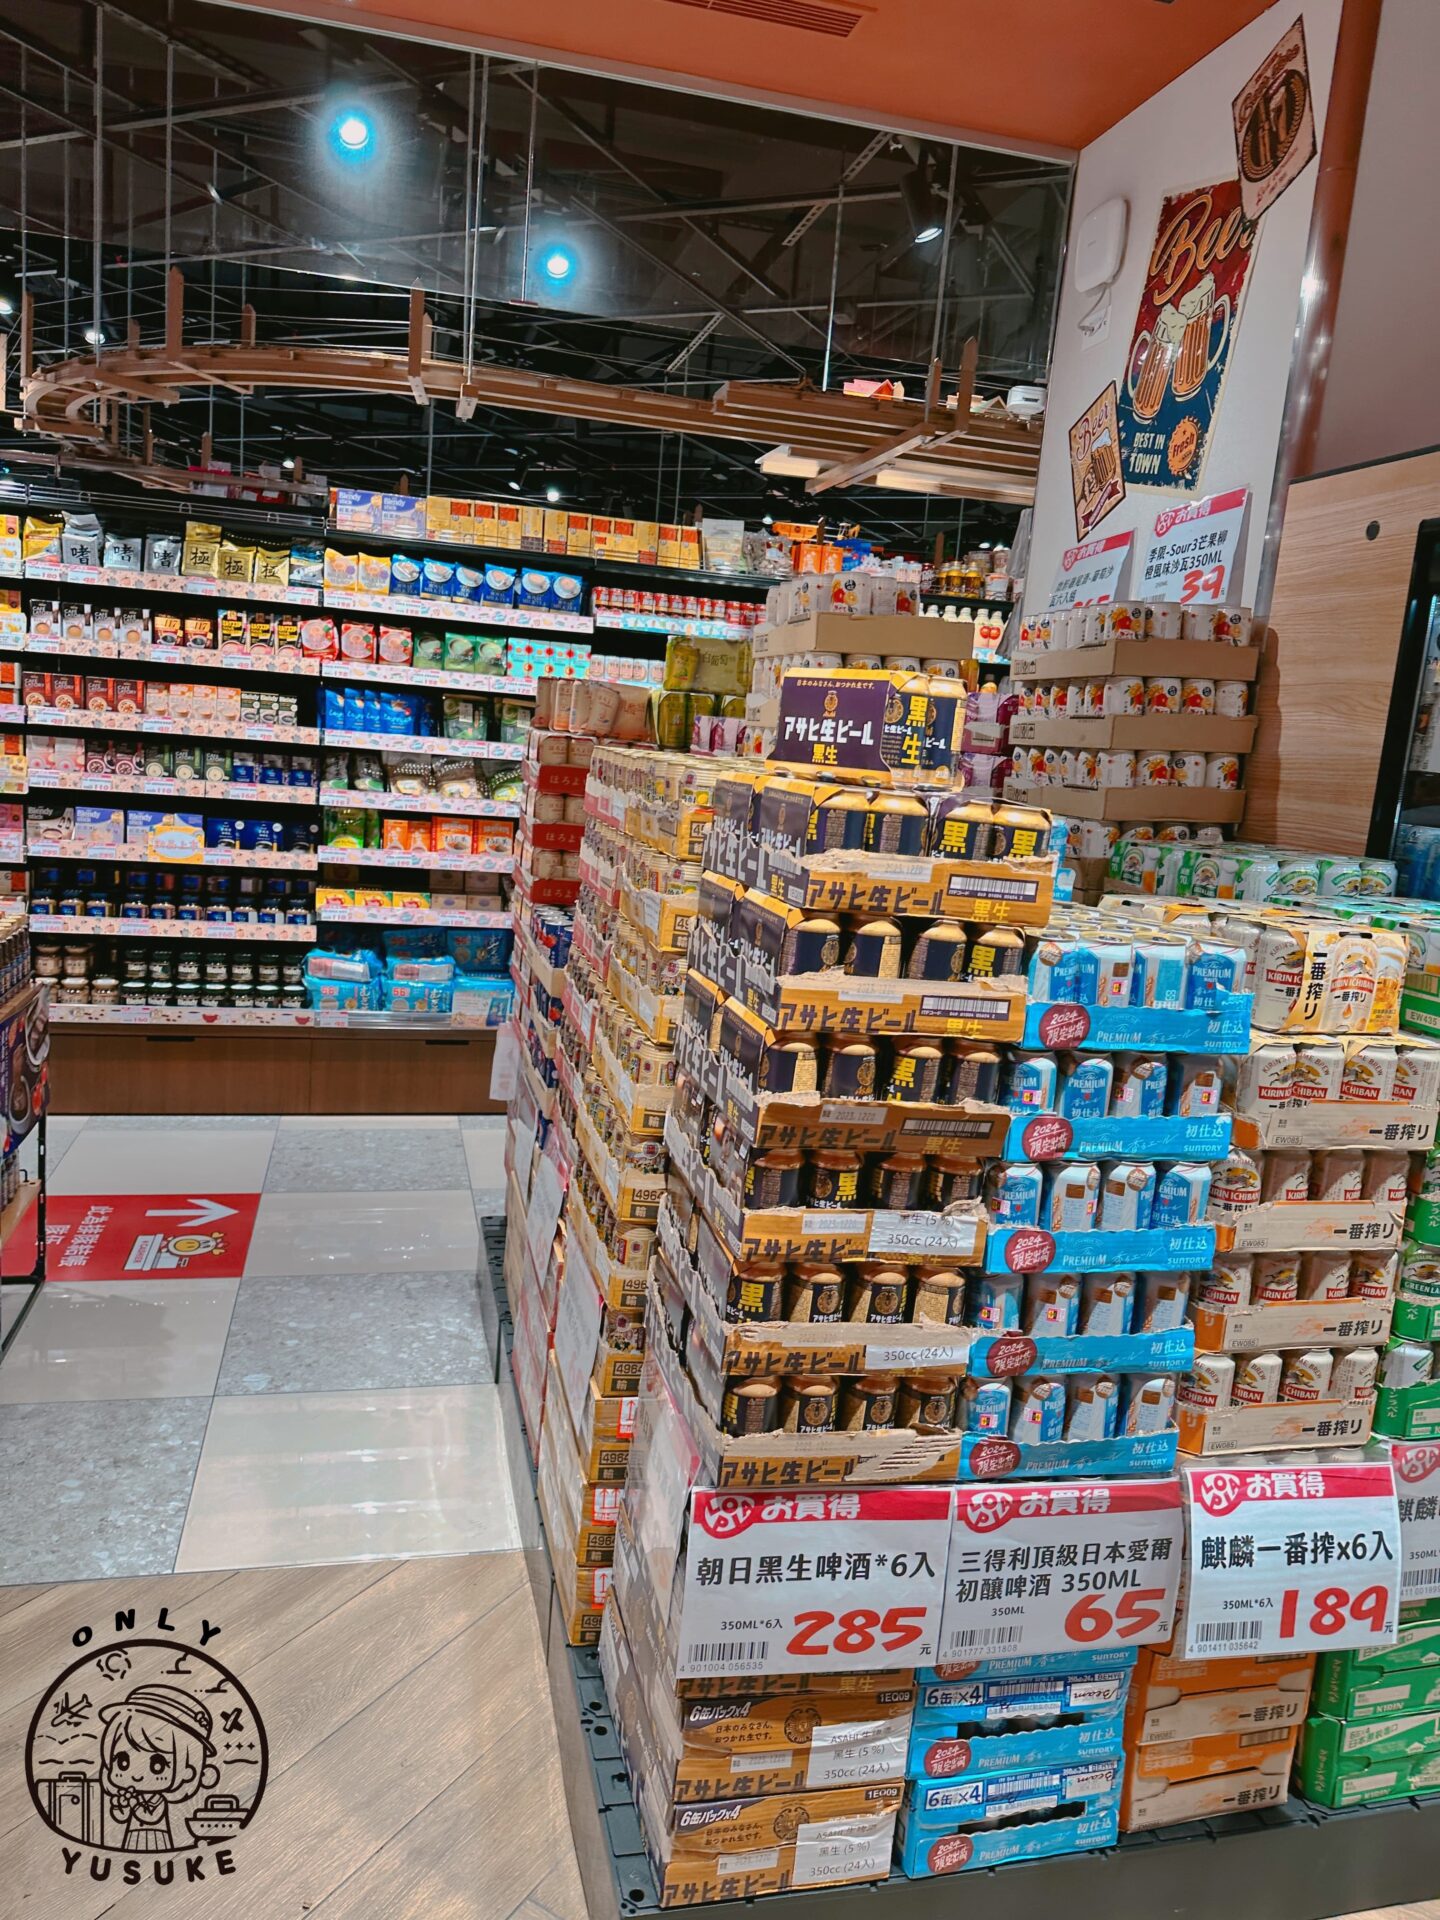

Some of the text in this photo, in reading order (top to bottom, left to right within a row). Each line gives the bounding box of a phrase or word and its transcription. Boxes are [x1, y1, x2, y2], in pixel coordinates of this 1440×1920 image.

[1133, 432, 1166, 450] BEST IN
[1172, 432, 1195, 458] Fresh
[1129, 453, 1162, 475] TOWN
[1180, 564, 1226, 605] 39
[784, 716, 874, 746] アサヒ生ビール
[811, 743, 838, 765] 黒生
[549, 775, 587, 787] ほろよ
[939, 820, 969, 854] 黒
[809, 878, 946, 914] アサヒ生ビール
[971, 898, 1011, 922] 黒生
[1191, 964, 1232, 979] PREMIUM
[1267, 971, 1292, 982] KIRIN
[779, 1003, 917, 1033] アサヒ生ビール
[1050, 1009, 1078, 1024] 2024
[1410, 1011, 1438, 1026] EW435
[945, 1018, 982, 1037] 黒生
[1096, 1030, 1141, 1044] PREMIUM
[890, 1056, 916, 1088] 黒
[1068, 1076, 1106, 1088] PREMIUM
[1261, 1088, 1284, 1097] KIRIN
[1342, 1085, 1378, 1098] ICHIBAN
[759, 1123, 897, 1149] アサヒ生ビール
[1032, 1122, 1061, 1137] 2024
[924, 1136, 962, 1155] 黒生
[1079, 1141, 1123, 1153] PREMIUM
[1184, 1144, 1222, 1153] SUNTORY
[887, 1234, 958, 1249] 350cc (24入)
[1015, 1235, 1043, 1249] 2024
[743, 1237, 880, 1263] アサヒ生ビー
[1062, 1254, 1107, 1266] PREMIUM
[1168, 1256, 1206, 1265] SUNTORY
[737, 1283, 765, 1313] 黒
[883, 1347, 954, 1361] 350cc (24入)
[998, 1342, 1025, 1355] 2024
[1042, 1357, 1088, 1368] PREMIUM
[980, 1443, 1007, 1457] 2024
[1025, 1460, 1070, 1471] PREMIUM
[1246, 1471, 1325, 1498] お買得
[760, 1494, 860, 1520] お買得
[1019, 1489, 1111, 1516] お買得
[1400, 1495, 1440, 1523] 麒麟
[958, 1537, 1173, 1573] 三得利頂級日本愛爾
[955, 1568, 1141, 1603] 初釀啤酒 350ML
[991, 1606, 1025, 1617] 350ML
[1064, 1588, 1166, 1643] 65
[1280, 1585, 1388, 1639] 189
[786, 1607, 927, 1656] 285
[1157, 1621, 1168, 1632] 元
[1384, 1621, 1393, 1633] 元
[919, 1643, 932, 1656] 元
[952, 1644, 1018, 1658] 901777 331808
[1092, 1651, 1130, 1661] SUNTORY
[690, 1664, 725, 1673] 901004
[728, 1662, 763, 1672] 056535
[988, 1656, 1032, 1670] PREMIUM
[1376, 1703, 1404, 1713] KIRIN
[716, 1721, 774, 1734] 日本のみなさん、
[715, 1731, 772, 1744] おつかれ生です。
[978, 1754, 1020, 1768] PREMIUM
[824, 1763, 890, 1780] 350cc (24入)
[979, 1845, 1020, 1861] PREMIUM
[810, 1859, 875, 1876] 350cc (24入)
[664, 1869, 793, 1906] アサヒ生ビール
